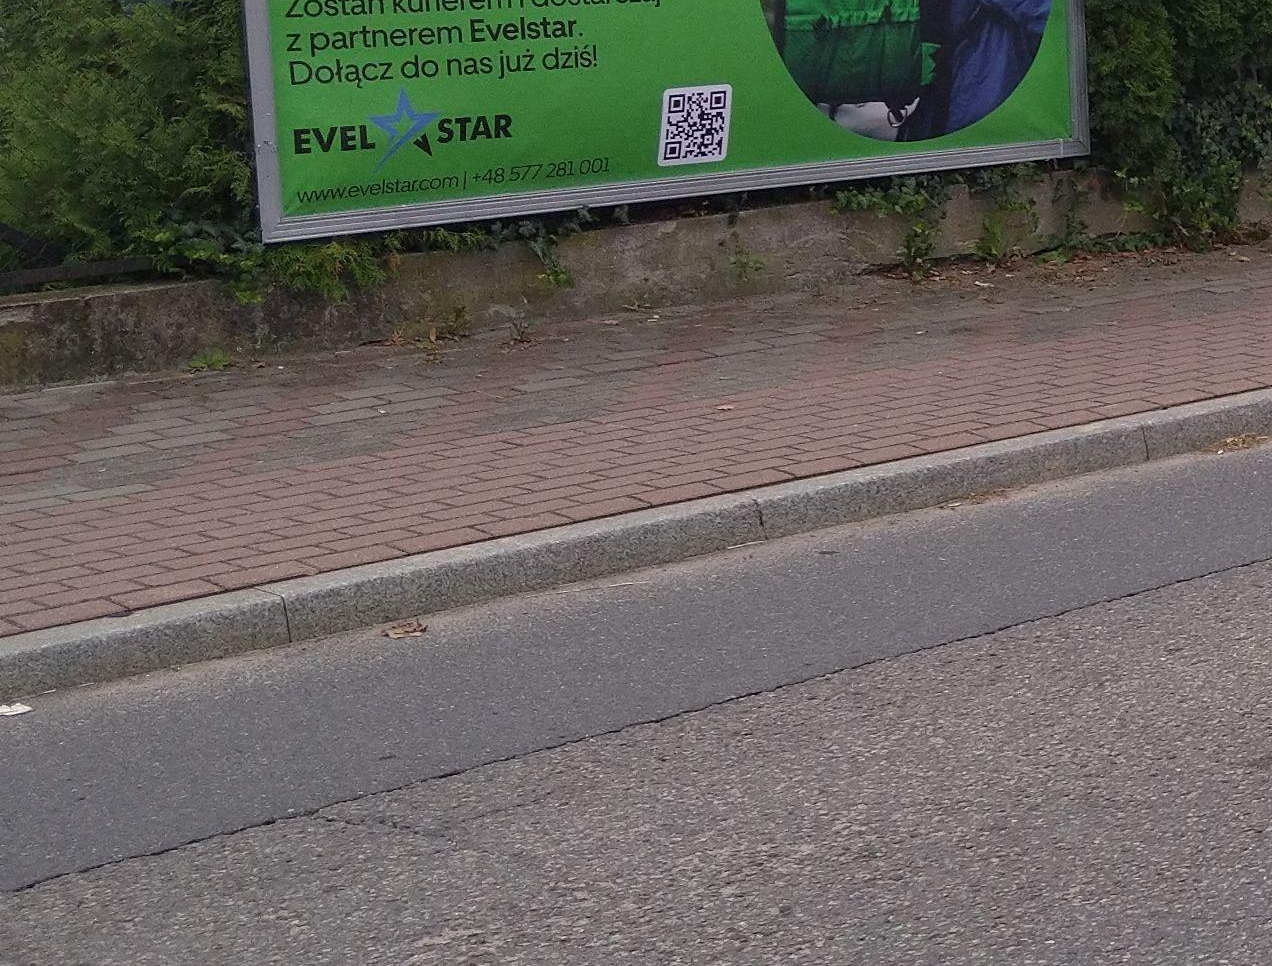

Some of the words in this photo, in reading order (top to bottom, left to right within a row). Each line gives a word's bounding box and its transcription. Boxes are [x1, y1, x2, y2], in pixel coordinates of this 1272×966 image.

[286, 33, 303, 52] z
[309, 25, 463, 58] partnerem
[469, 16, 584, 43] Evelstar.
[288, 58, 394, 89] Dołącz
[400, 54, 439, 79] do
[446, 55, 493, 76] nas
[498, 49, 536, 80] już
[542, 44, 598, 71] dziś!
[293, 124, 376, 155] EVEL
[436, 113, 513, 144] STAR
[296, 175, 459, 204] www.evelstar.com
[472, 167, 505, 185] +48
[509, 163, 544, 182] 577
[545, 160, 576, 179] 281
[579, 157, 611, 174] 001
